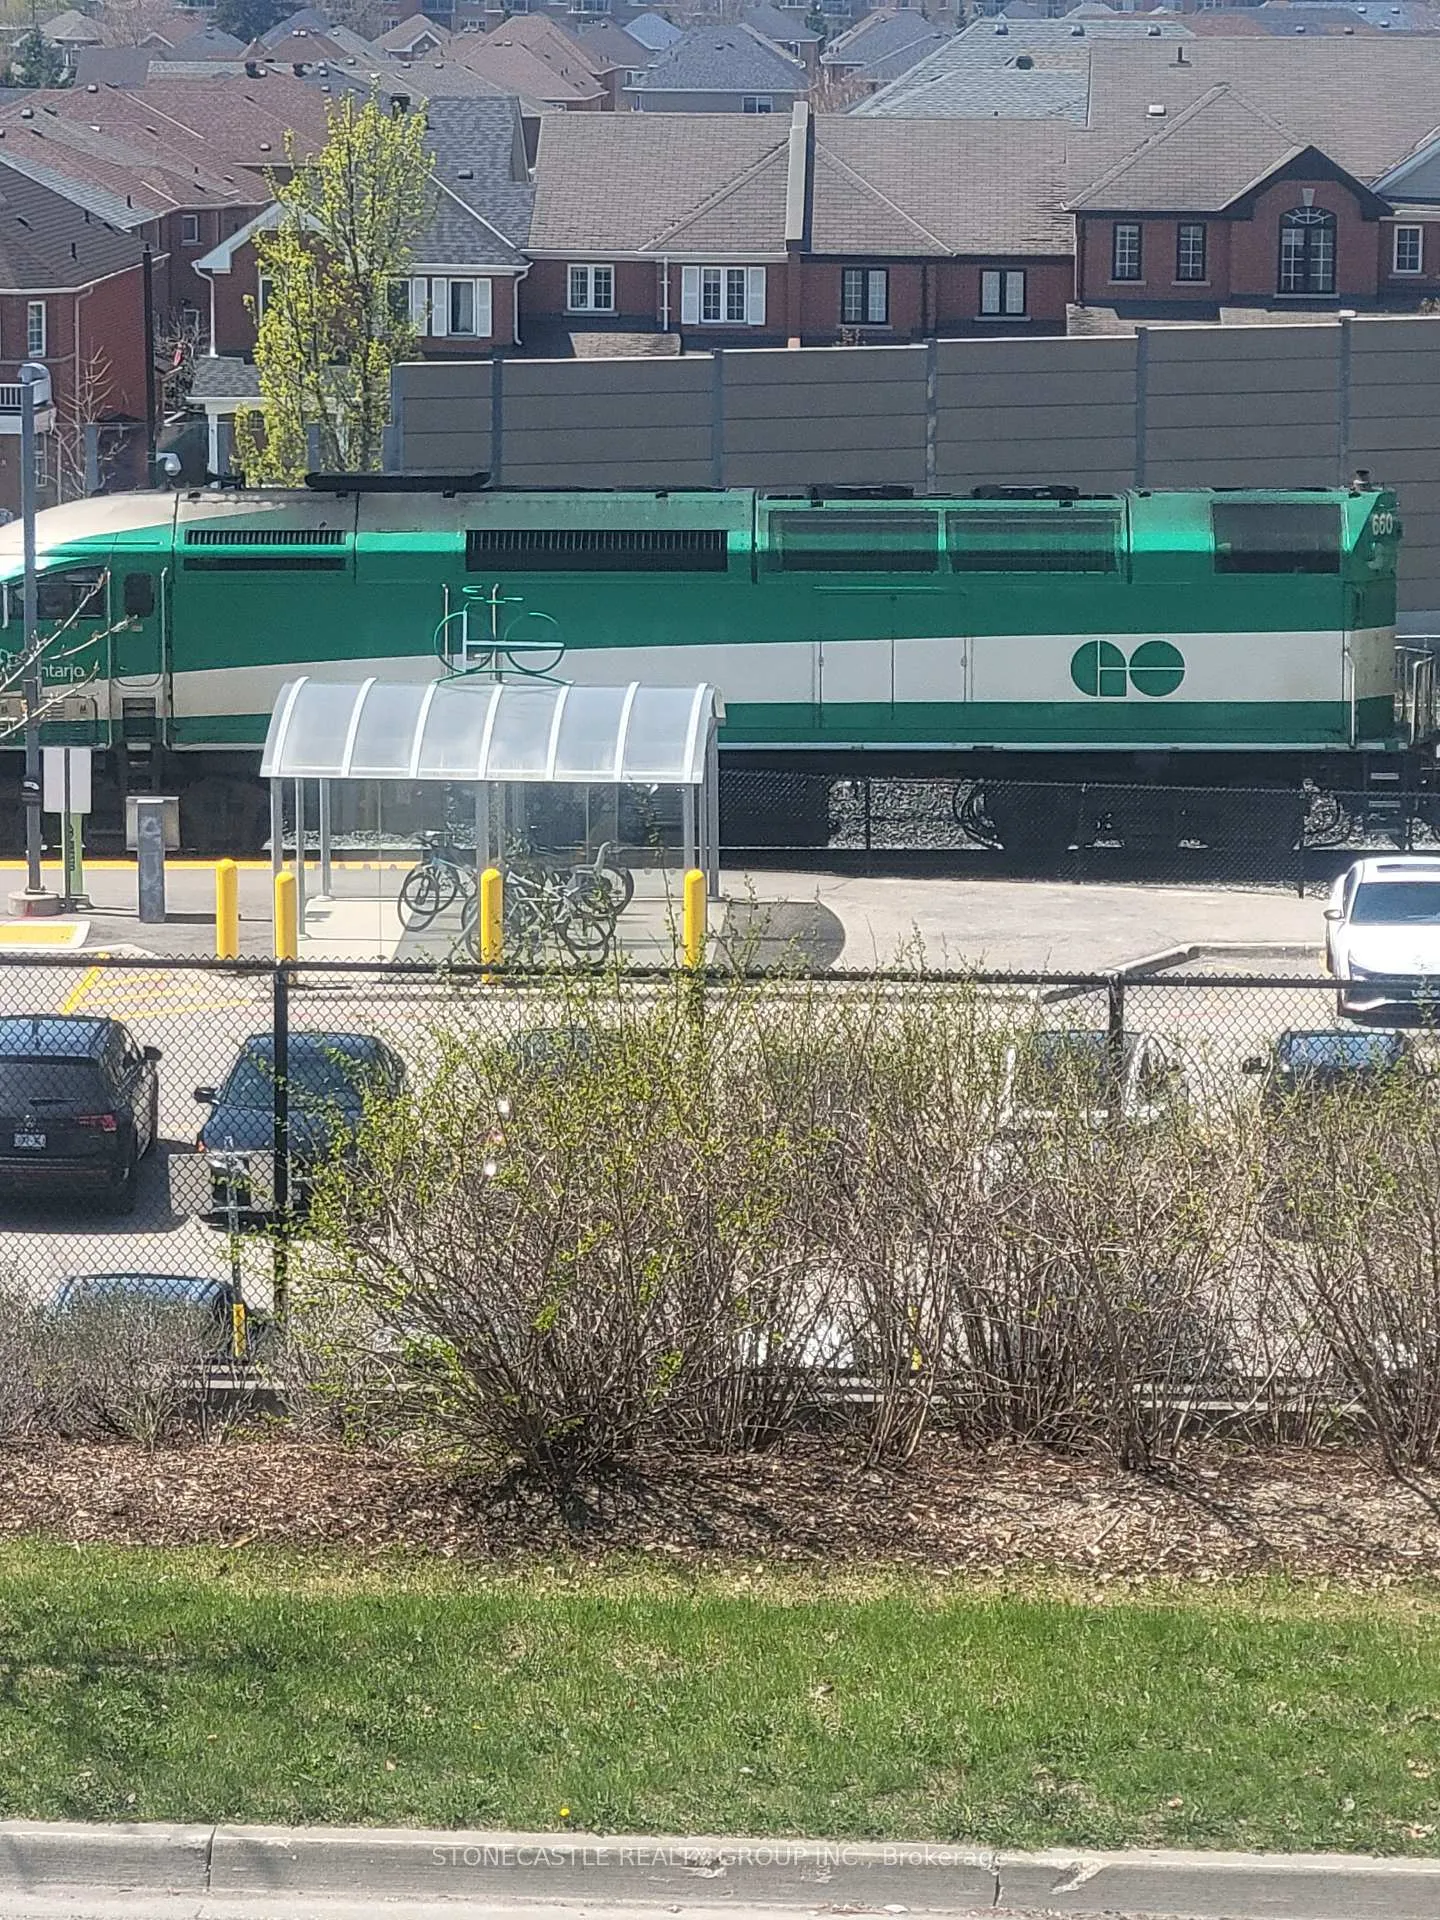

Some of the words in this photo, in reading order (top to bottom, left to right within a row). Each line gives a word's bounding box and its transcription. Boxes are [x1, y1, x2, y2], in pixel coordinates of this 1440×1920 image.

[1372, 513, 1393, 535] 660
[41, 663, 85, 681] ntario
[1070, 639, 1186, 697] GO
